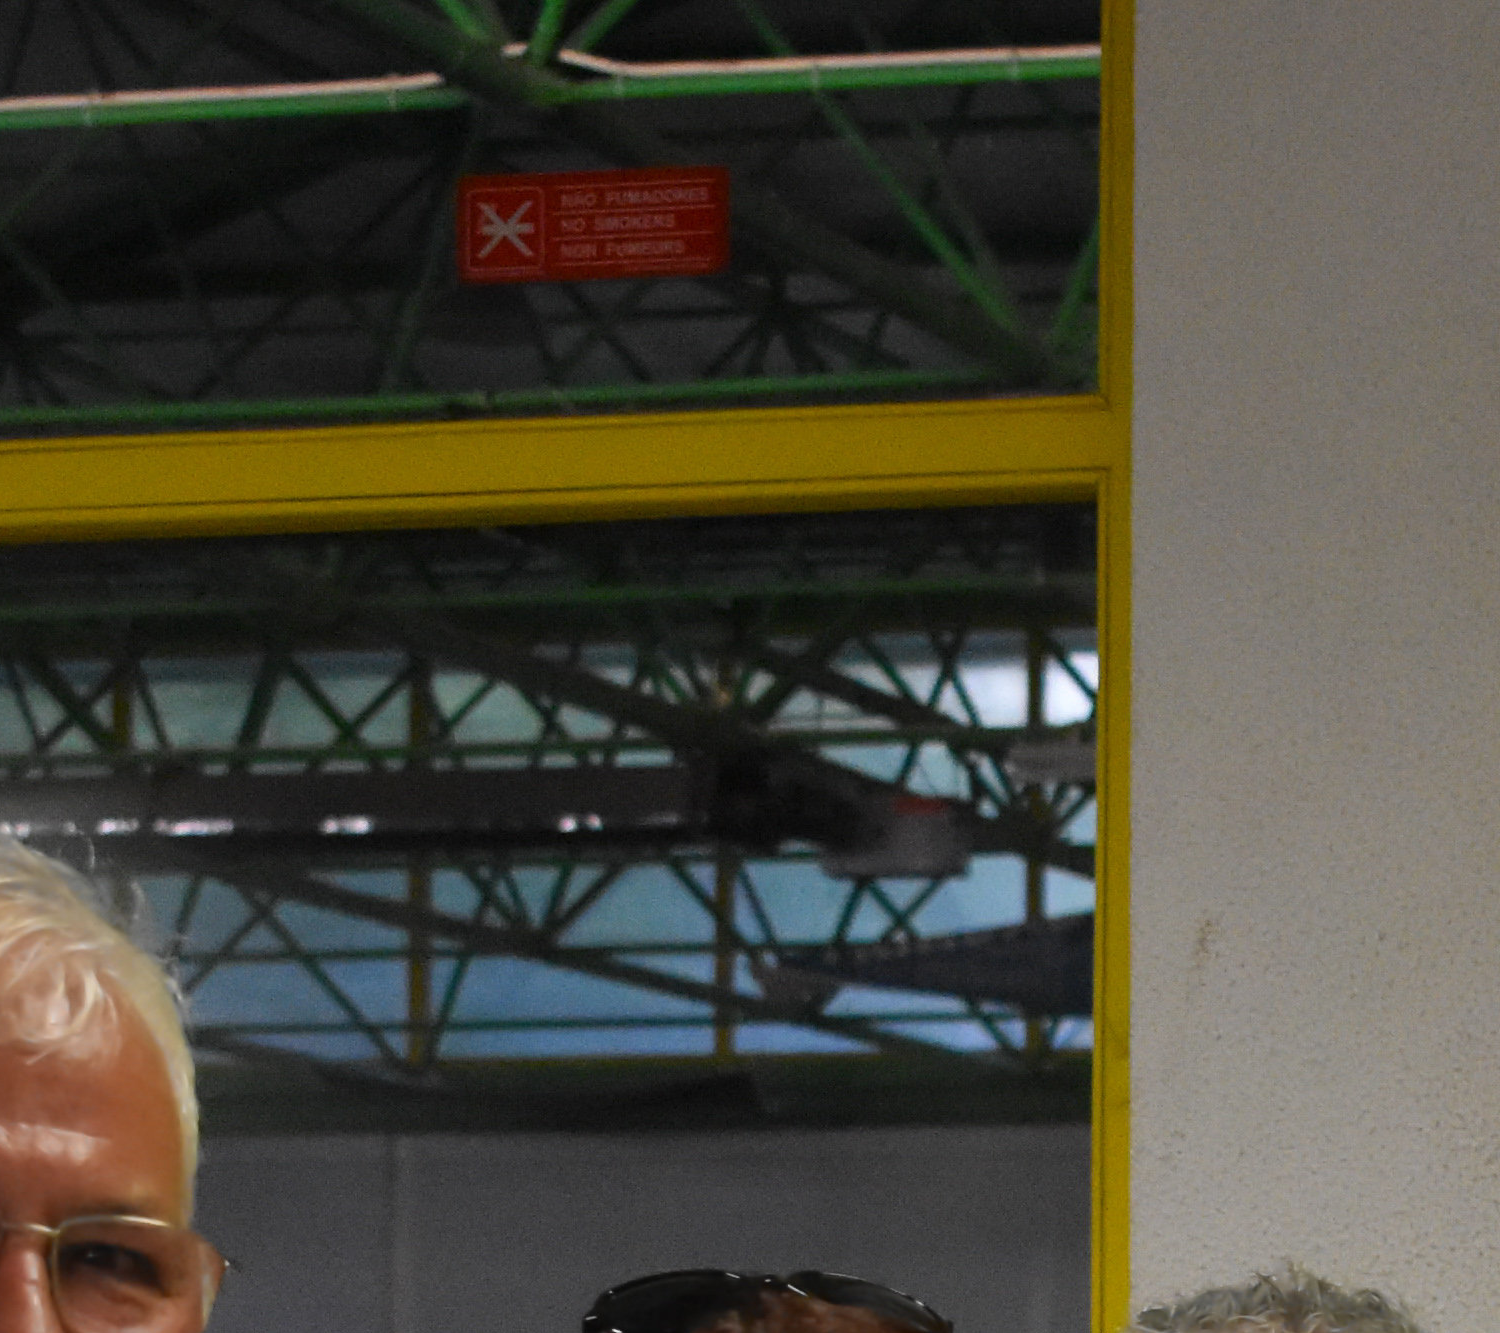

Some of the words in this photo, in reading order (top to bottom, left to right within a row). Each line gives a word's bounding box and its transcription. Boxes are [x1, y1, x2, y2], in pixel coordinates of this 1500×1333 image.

[561, 191, 597, 208] NÃO
[605, 186, 709, 207] FUMADORES
[560, 217, 587, 233] NO
[594, 213, 676, 231] SMOKERS
[605, 239, 684, 256] FUMEURS
